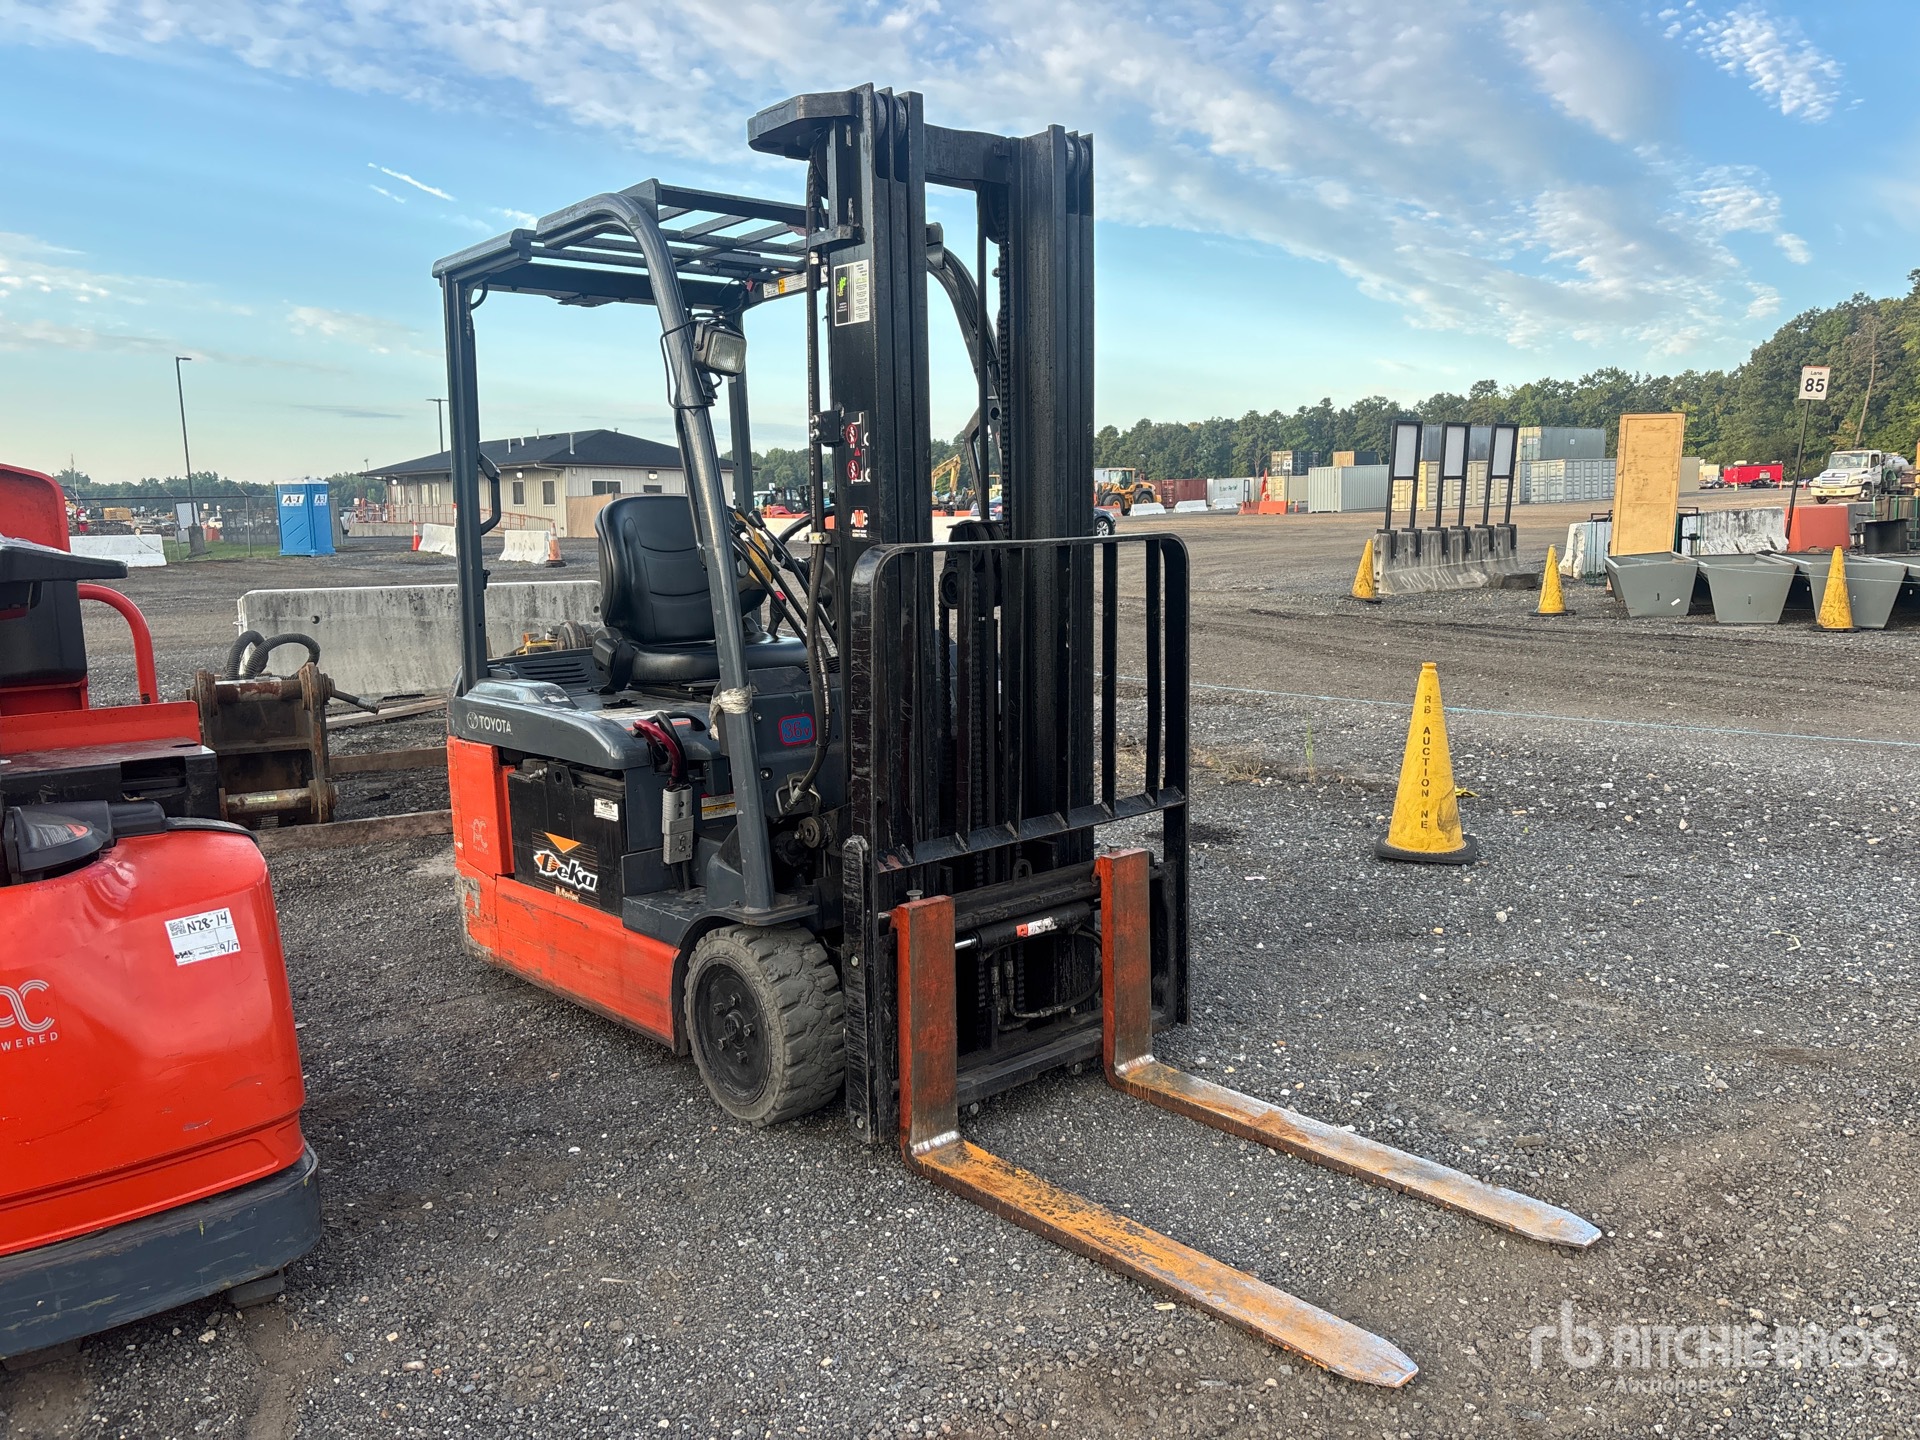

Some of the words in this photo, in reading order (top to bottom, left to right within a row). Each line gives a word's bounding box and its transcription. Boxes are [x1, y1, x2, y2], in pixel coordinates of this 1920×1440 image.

[1805, 378, 1825, 392] 85
[284, 495, 301, 503] A-1
[479, 715, 512, 733] TOYOTA
[1421, 726, 1431, 798] AUCTION
[1421, 810, 1428, 829] NE
[533, 850, 598, 891] Deka
